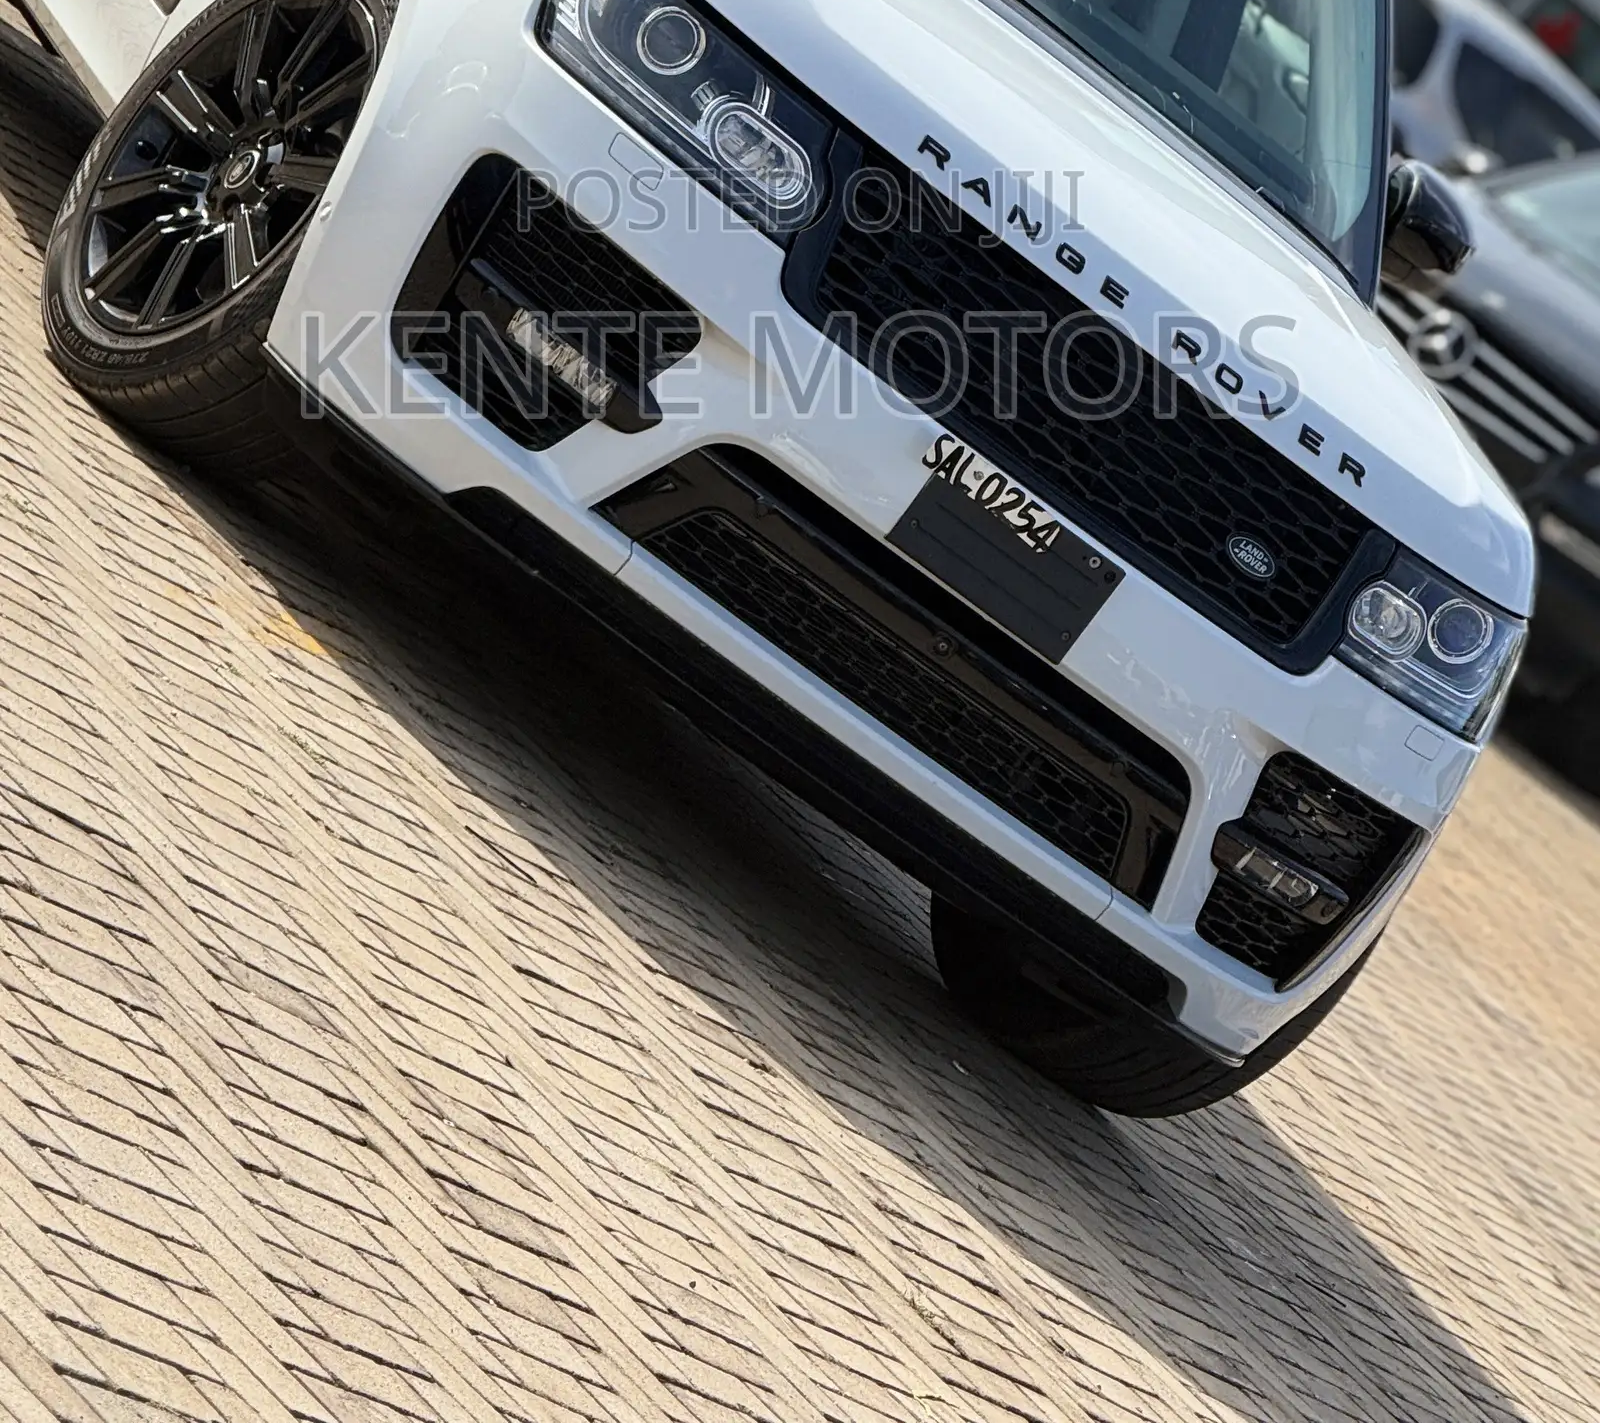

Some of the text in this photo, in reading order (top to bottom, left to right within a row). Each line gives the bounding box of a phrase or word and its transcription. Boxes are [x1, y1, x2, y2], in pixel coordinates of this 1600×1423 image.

[917, 134, 1367, 488] RANGE ROVER
[1237, 550, 1268, 574] ROVER
[1239, 540, 1265, 560] LAND
